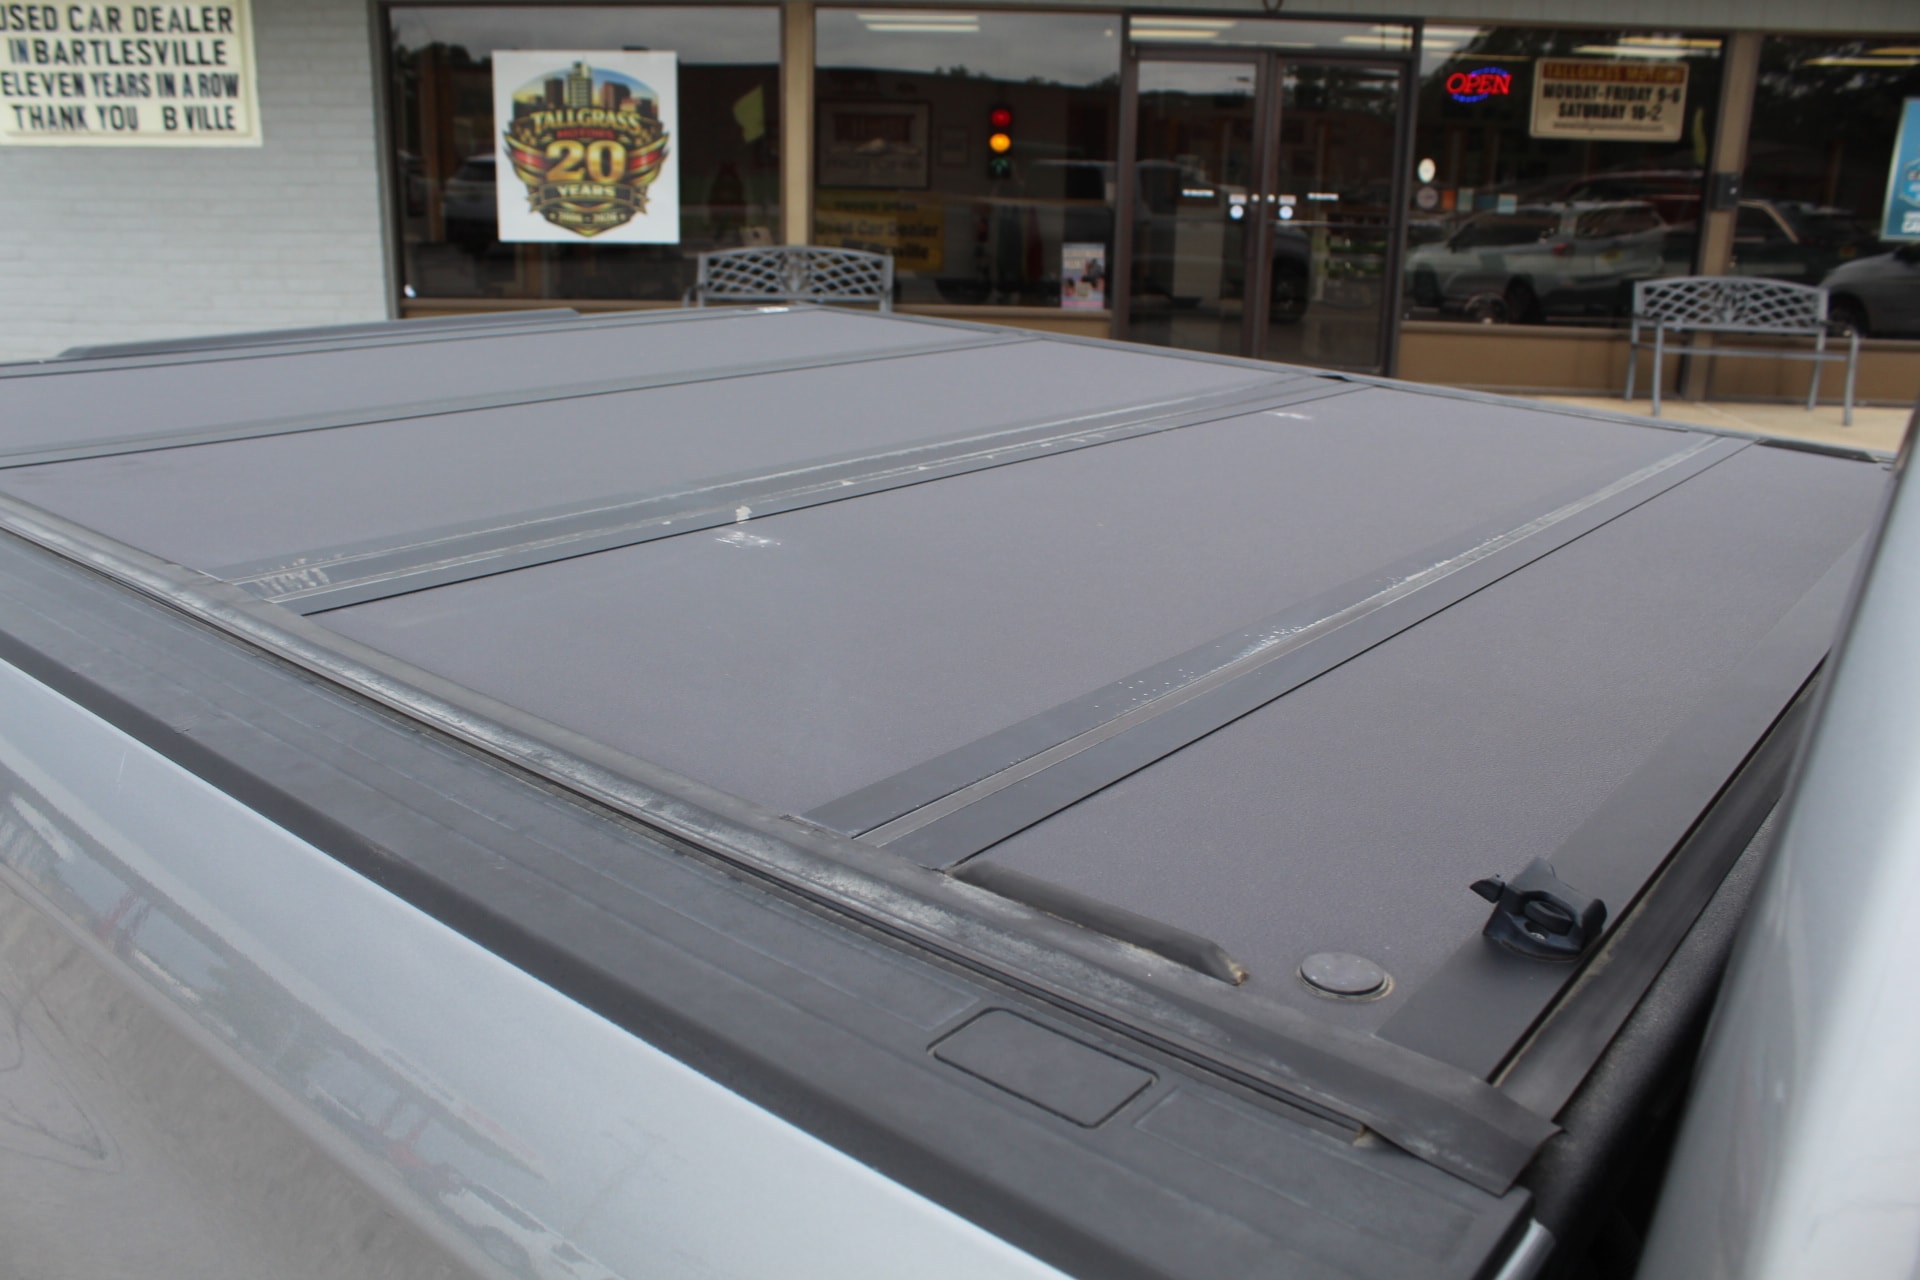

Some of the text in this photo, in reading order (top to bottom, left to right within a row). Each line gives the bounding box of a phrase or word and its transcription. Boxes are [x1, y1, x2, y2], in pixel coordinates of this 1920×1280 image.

[68, 6, 122, 33] CAR
[133, 6, 234, 33] DEALER
[8, 38, 228, 66] IN BARTLESVILLE
[1, 71, 239, 98] ELEVEN YEARS IN A ROW
[1446, 72, 1513, 95] OPEN
[1543, 83, 1653, 100] MONDAY-FRIDAY
[12, 104, 89, 131] THANK
[97, 105, 139, 130] YOU
[530, 108, 643, 134] TALLGRASS
[1558, 102, 1626, 119] SATURDAY
[546, 140, 627, 183] 20
[557, 185, 617, 198] YEARS
